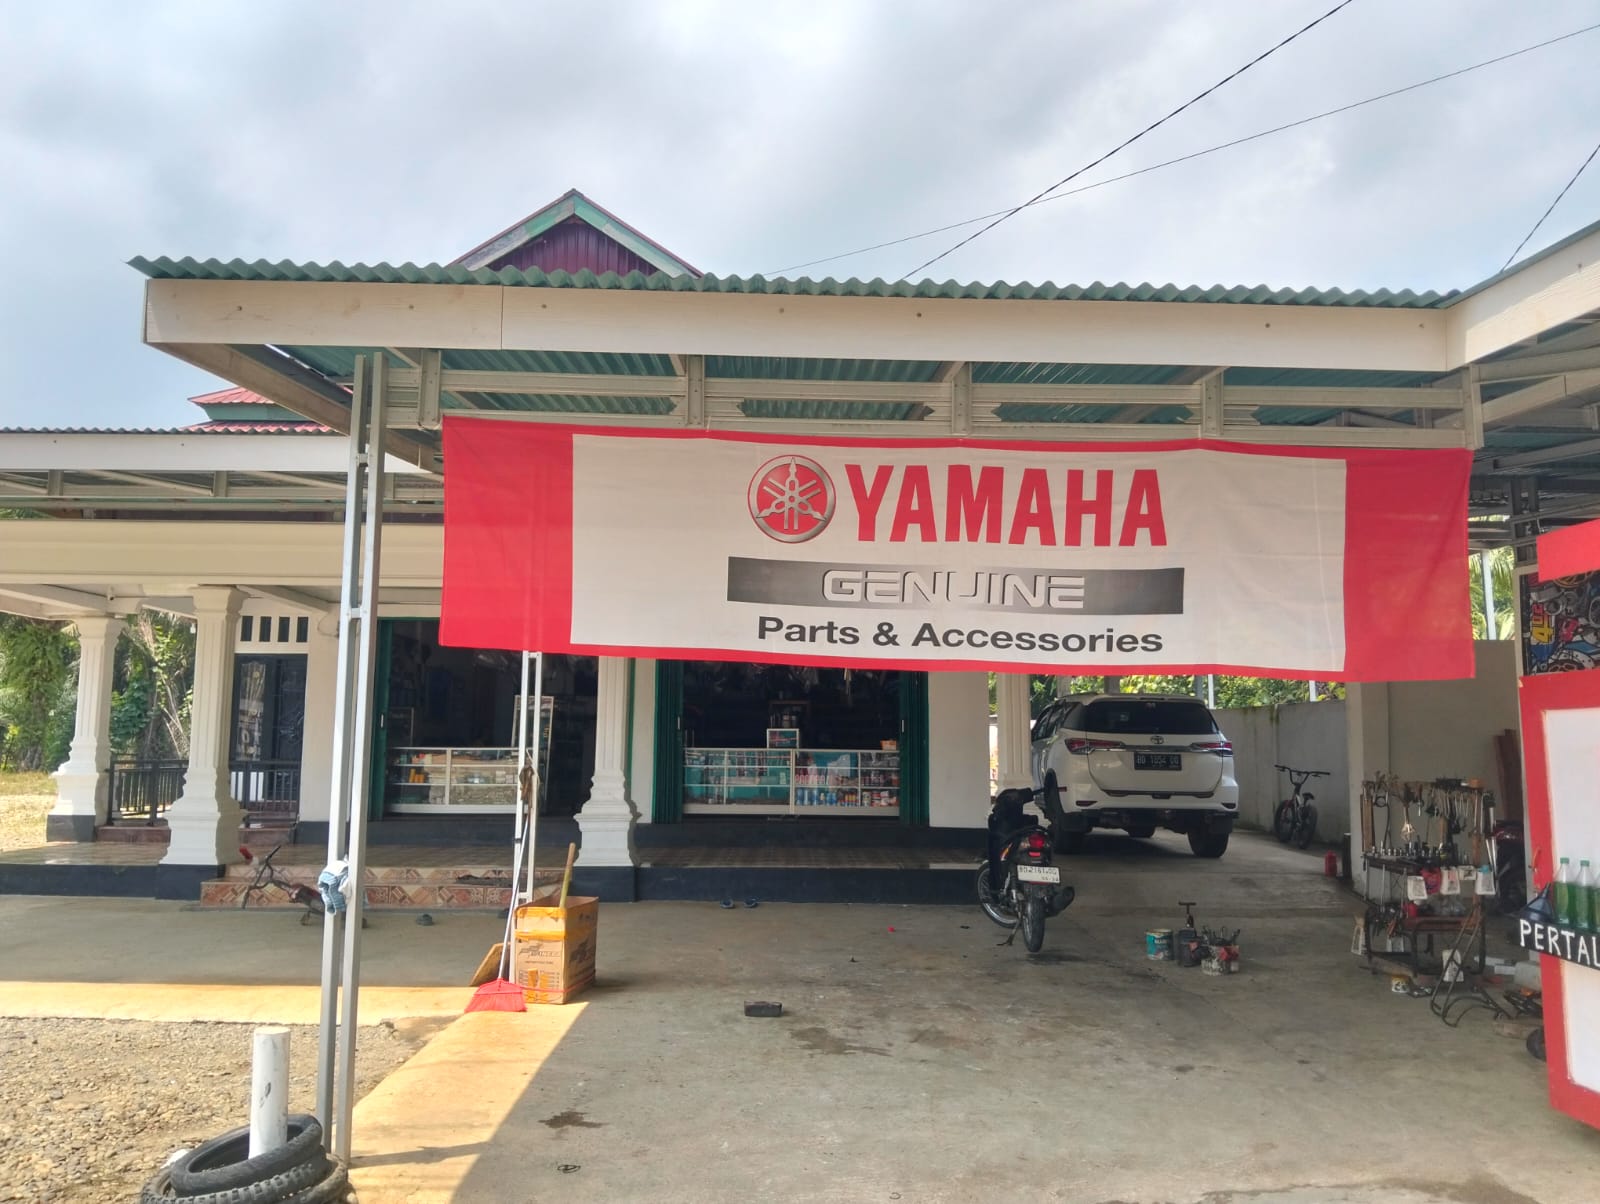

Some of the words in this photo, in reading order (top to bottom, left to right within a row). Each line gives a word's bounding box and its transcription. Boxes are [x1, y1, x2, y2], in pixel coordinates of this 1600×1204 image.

[845, 464, 1168, 547] YAMAHA
[822, 569, 1086, 609] GENUINE
[757, 616, 860, 645] Parts
[872, 622, 900, 647] &
[911, 622, 1164, 653] Accessories
[1519, 918, 1600, 969] PERTAL
